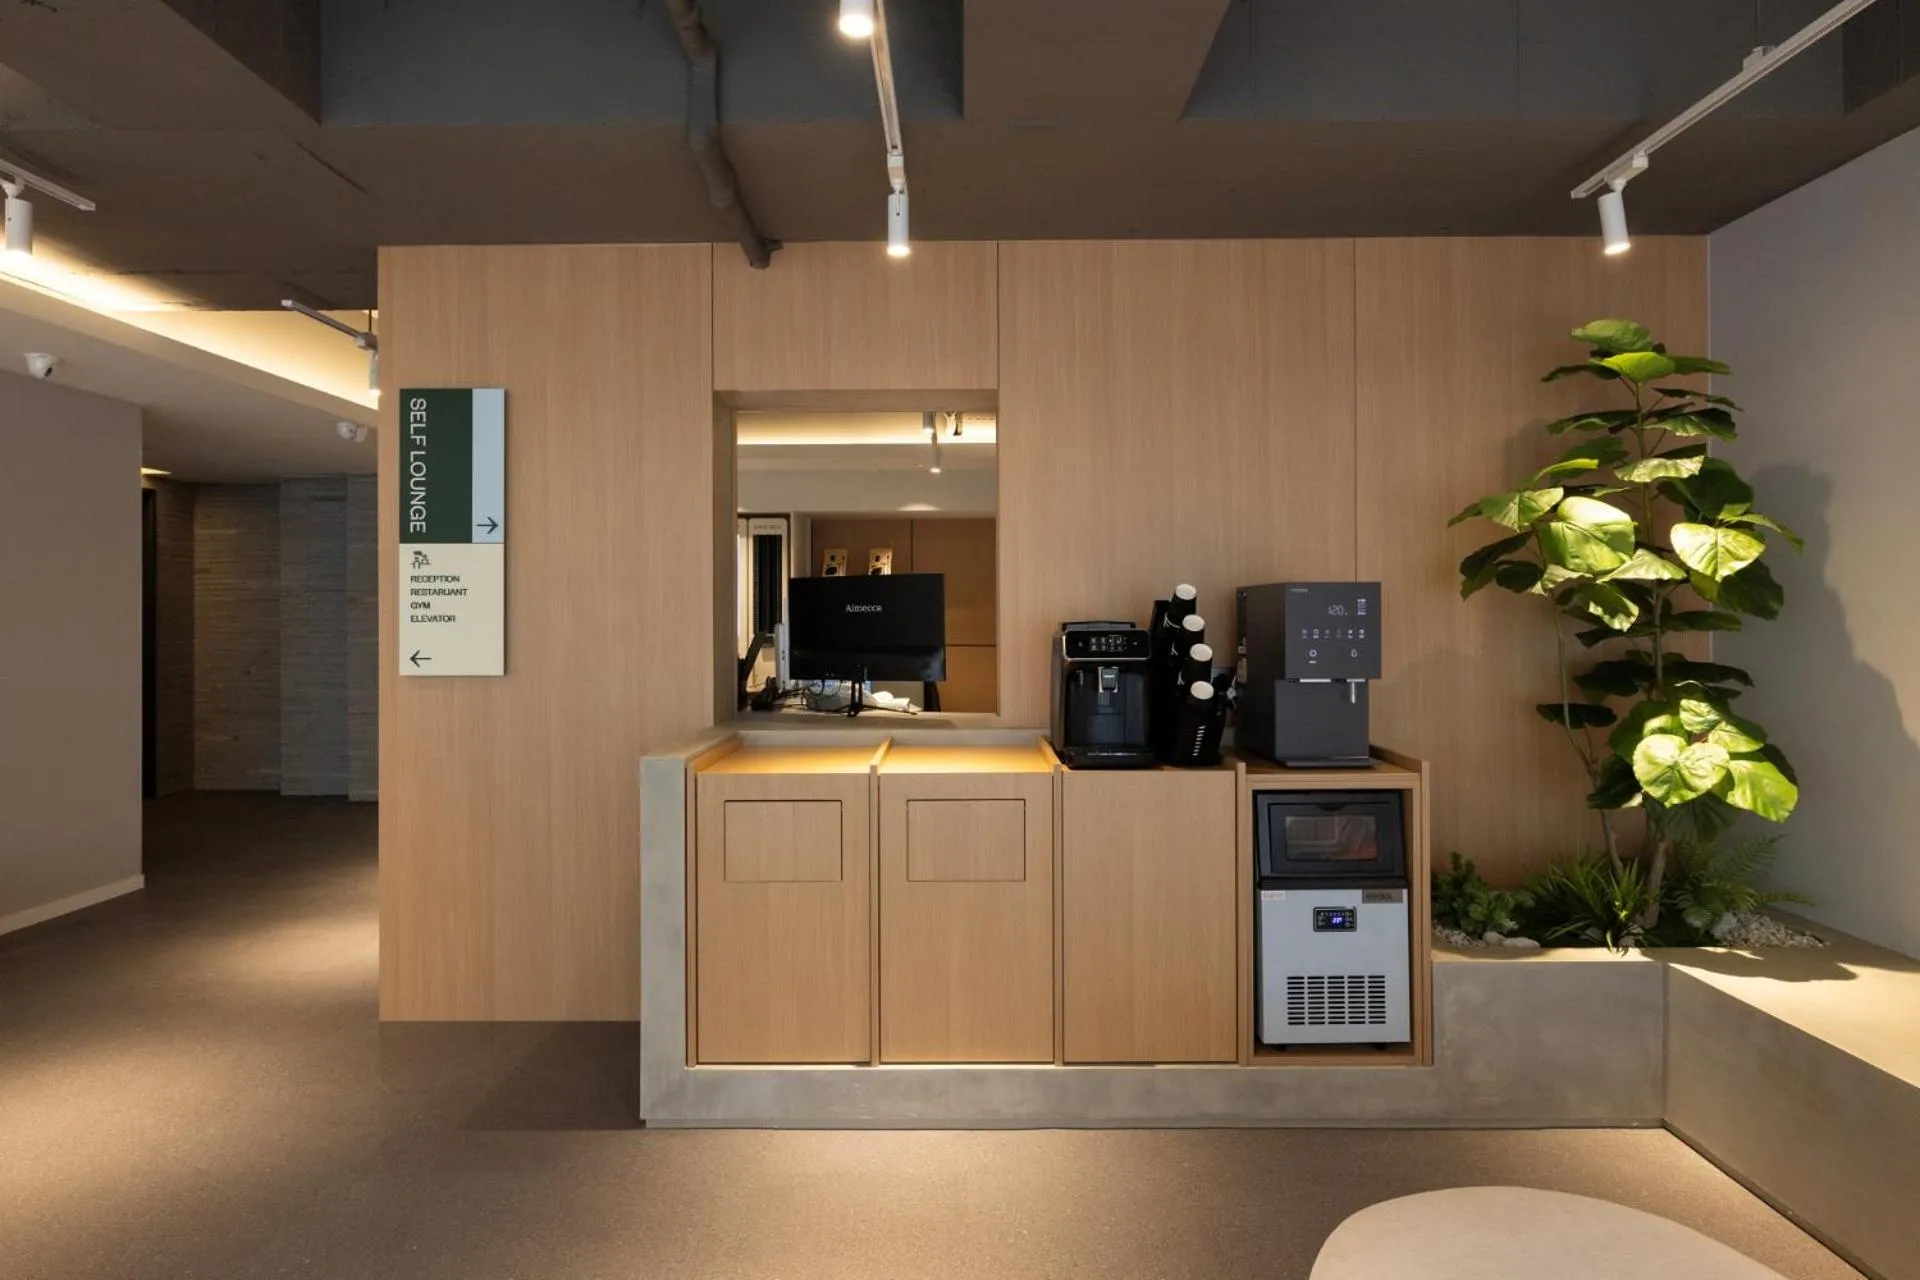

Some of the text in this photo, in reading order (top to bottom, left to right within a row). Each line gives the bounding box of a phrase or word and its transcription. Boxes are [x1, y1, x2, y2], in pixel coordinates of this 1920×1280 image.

[410, 397, 426, 533] SELF LOUNGE
[410, 575, 460, 583] RECEPTION
[410, 601, 431, 609] GYM
[410, 614, 456, 623] ELEVATOR
